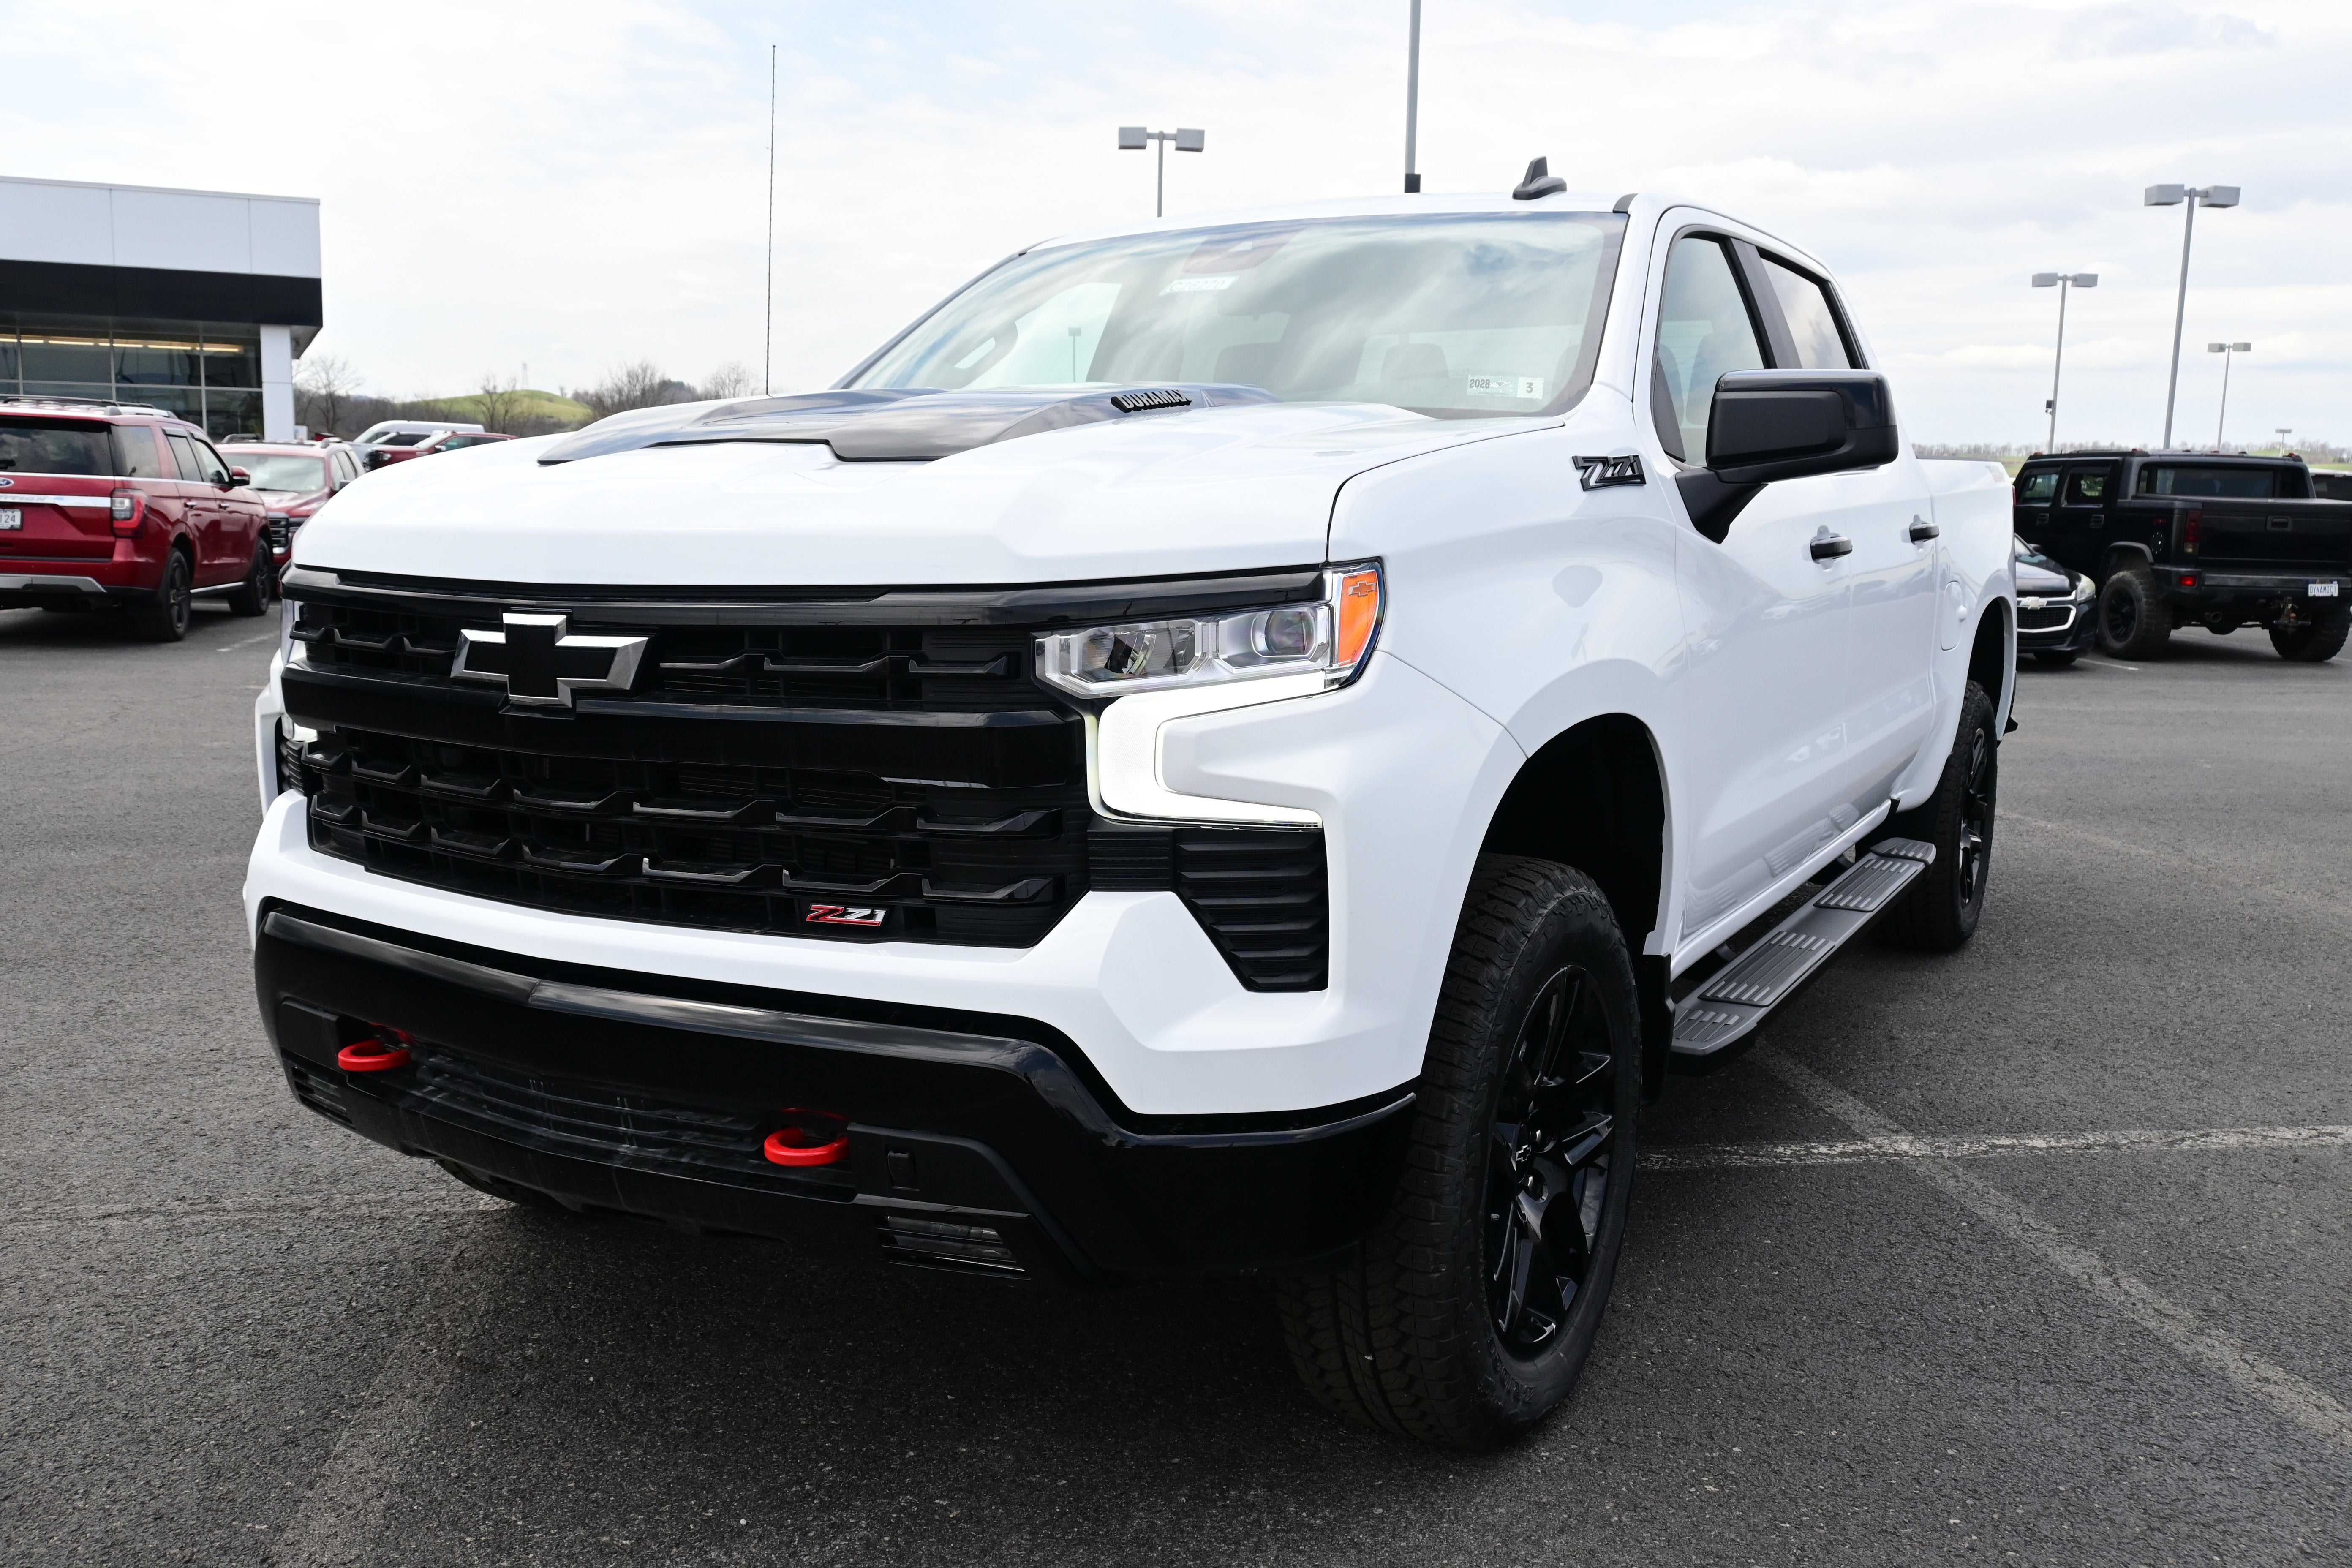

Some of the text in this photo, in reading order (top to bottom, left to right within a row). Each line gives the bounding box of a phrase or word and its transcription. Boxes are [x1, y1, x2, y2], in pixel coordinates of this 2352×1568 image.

[1169, 280, 1225, 291] C26270
[1469, 378, 1491, 389] 2028
[1526, 382, 1534, 393] 3
[1115, 389, 1192, 411] DURAMAX
[1572, 455, 1647, 491] Z71
[806, 904, 886, 927] Z71
